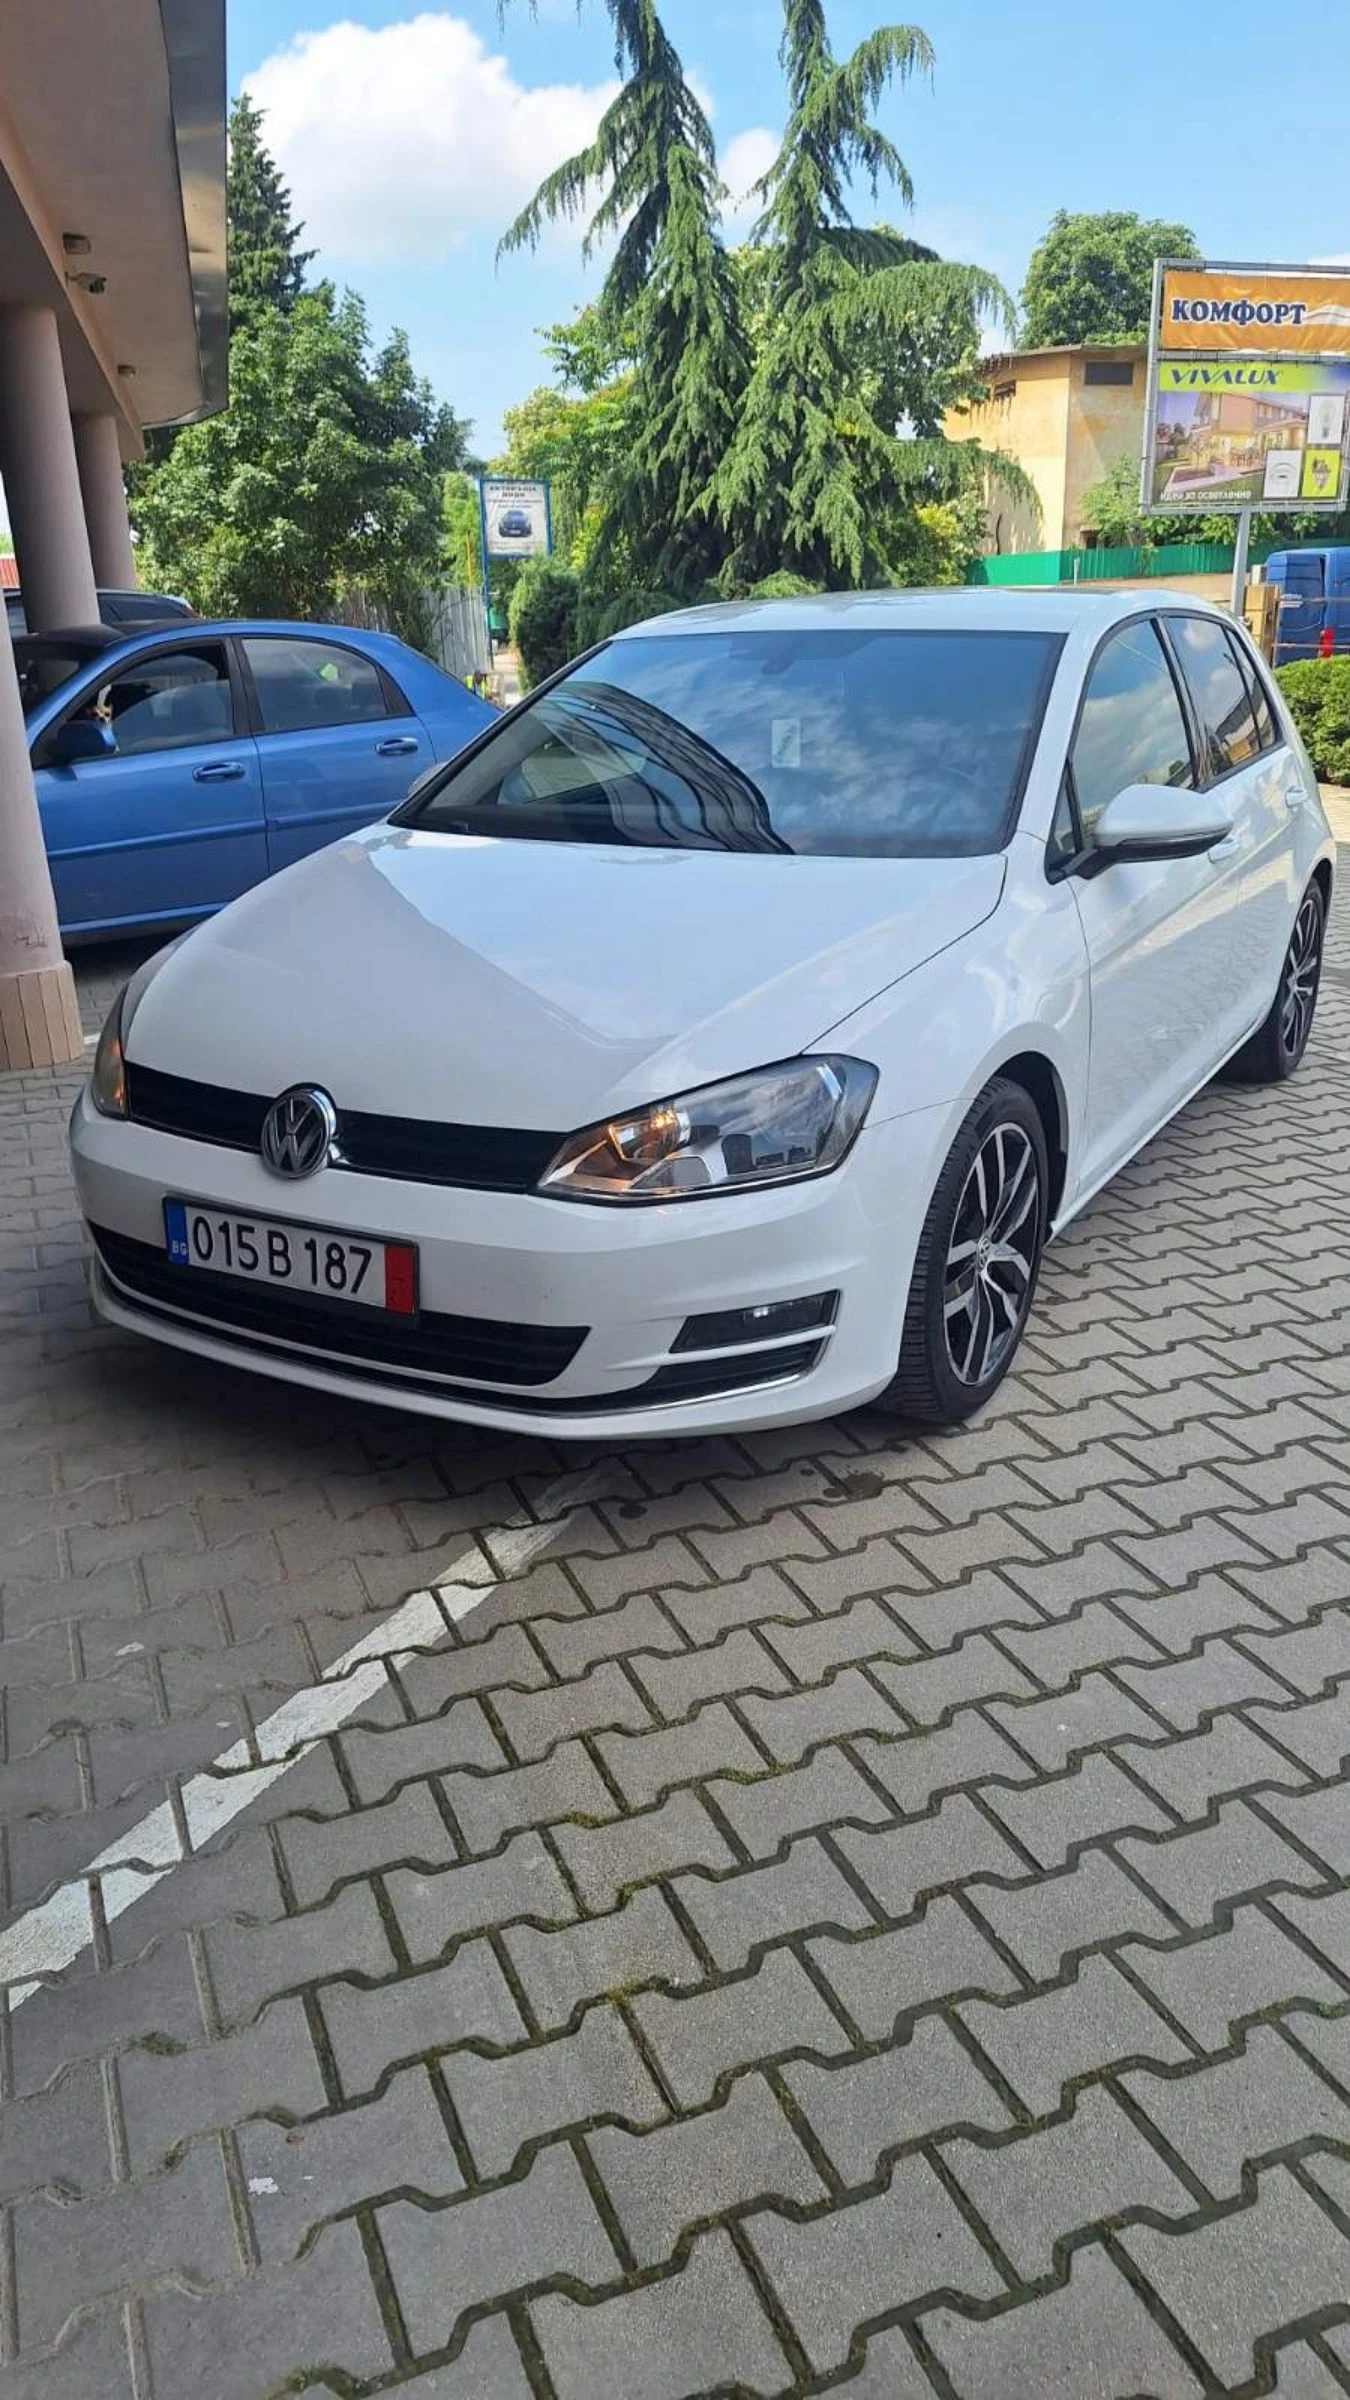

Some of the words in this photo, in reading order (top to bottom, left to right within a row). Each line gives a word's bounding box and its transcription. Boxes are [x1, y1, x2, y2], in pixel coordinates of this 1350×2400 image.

[1171, 299, 1306, 326] КОМФОРТ
[1171, 369, 1281, 385] VIVALUX
[172, 1241, 187, 1255] BG
